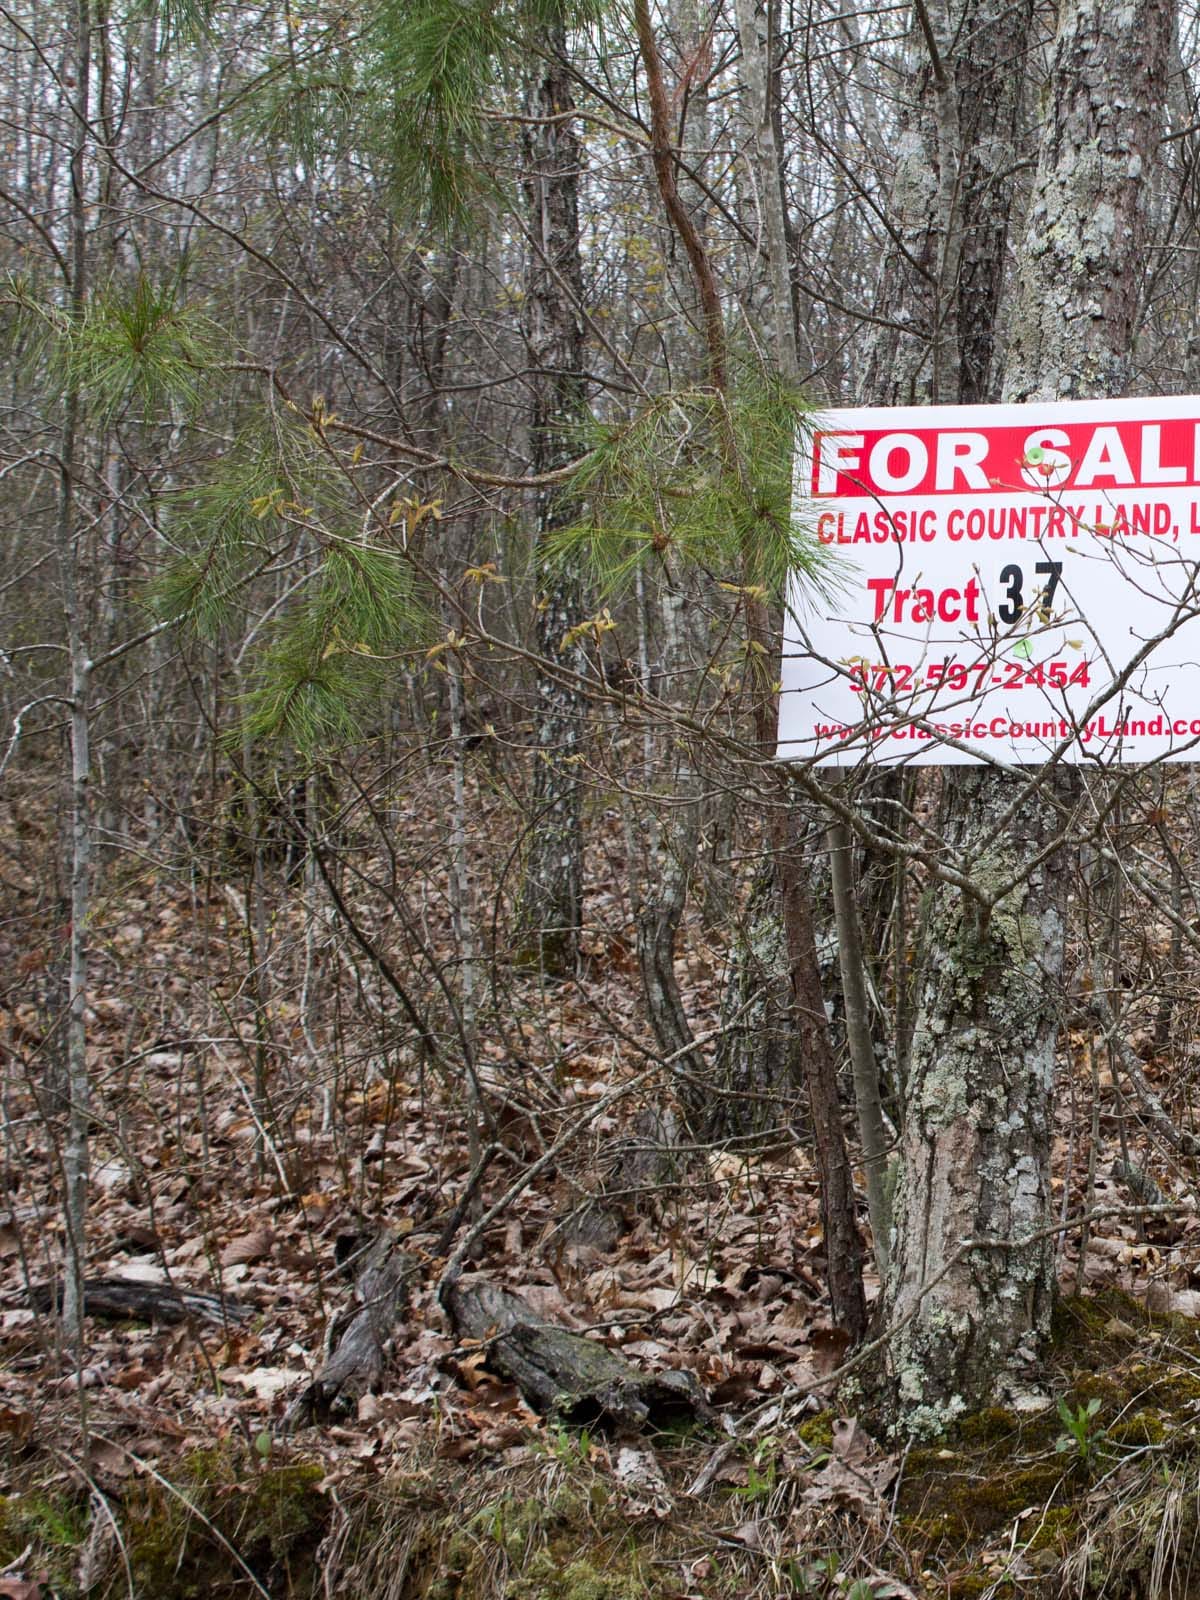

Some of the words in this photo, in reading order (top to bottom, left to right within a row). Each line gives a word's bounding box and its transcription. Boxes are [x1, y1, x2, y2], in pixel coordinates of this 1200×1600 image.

[818, 431, 992, 493] FOR
[817, 509, 937, 544] CLASSIC
[947, 504, 1086, 541] COUNTRY
[1095, 502, 1179, 542] LAND,
[867, 576, 979, 623] Tract
[999, 561, 1063, 625] 37
[849, 660, 1091, 693] 972-597-2454
